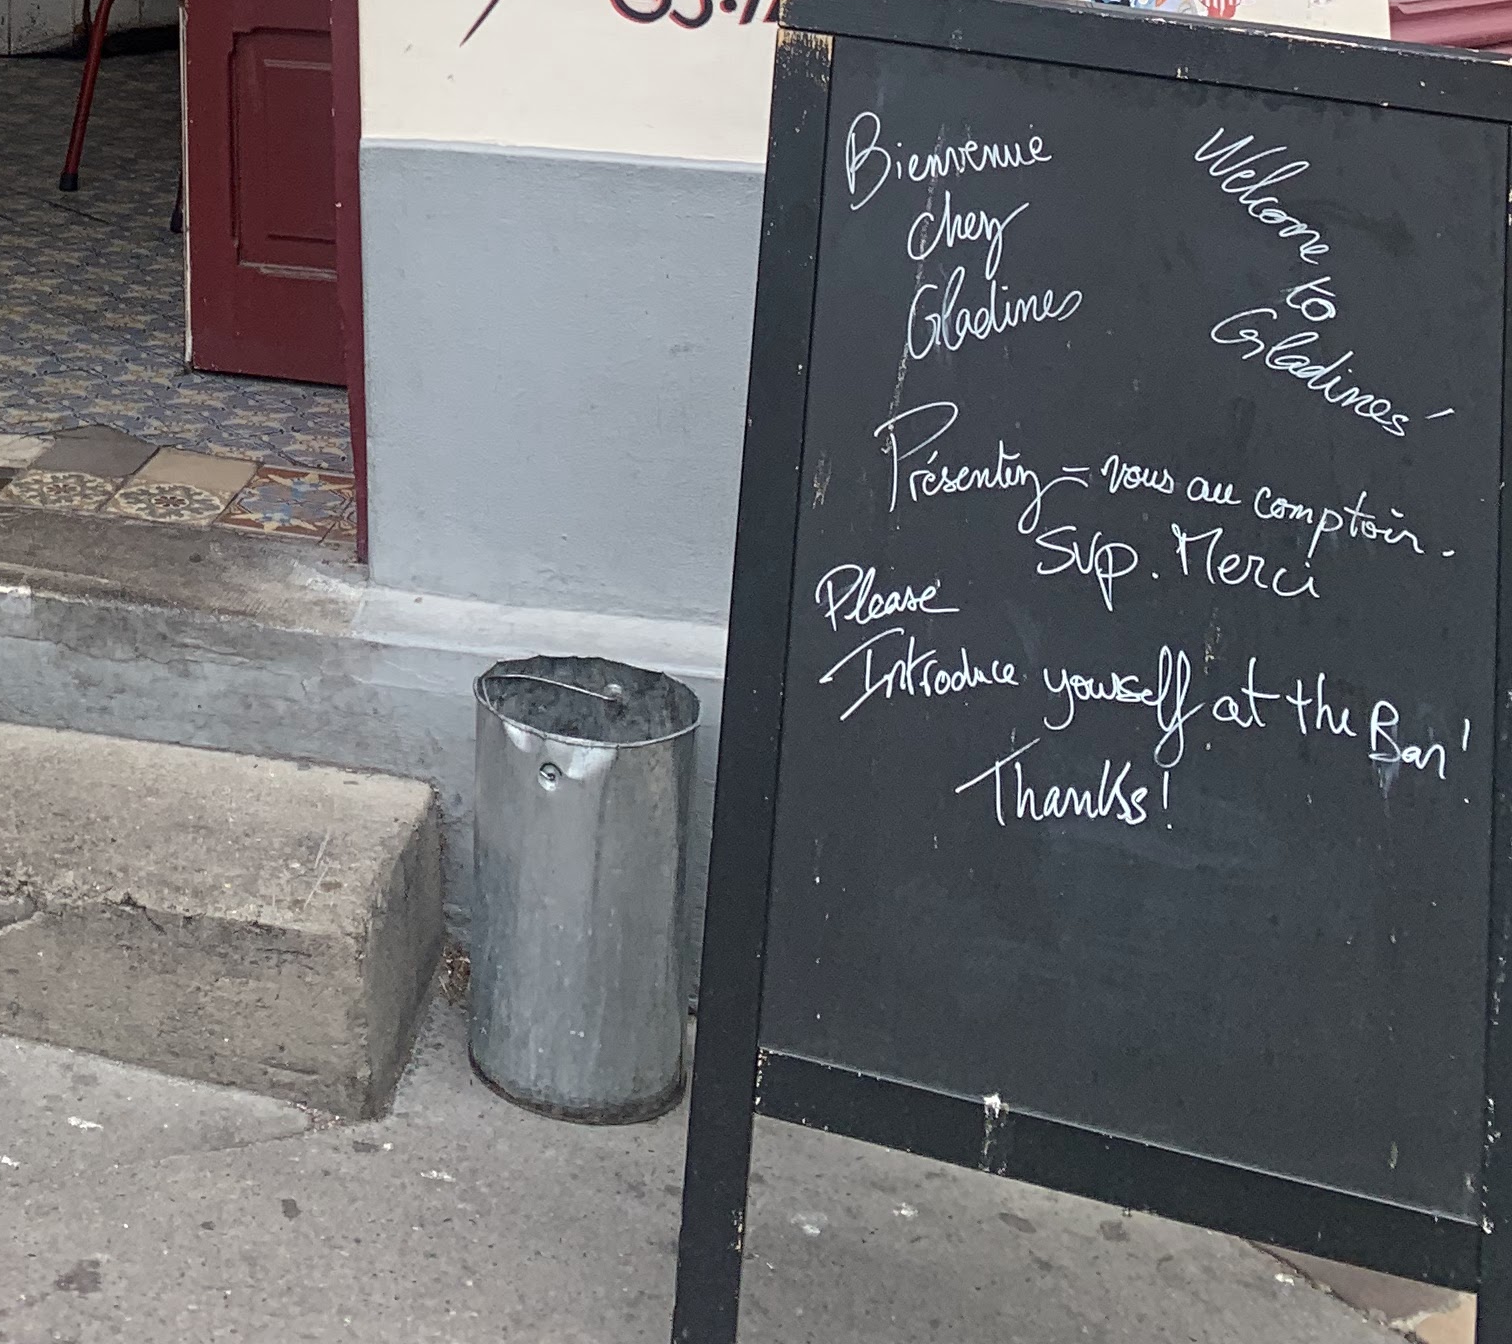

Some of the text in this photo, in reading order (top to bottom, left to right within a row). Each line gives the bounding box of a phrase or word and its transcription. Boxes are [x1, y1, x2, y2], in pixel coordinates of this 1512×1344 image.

[844, 111, 1054, 211] Bienvenue
[1193, 127, 1332, 266] Welcome
[906, 266, 1084, 361] Gladines
[1285, 275, 1338, 324] to
[1186, 476, 1242, 507] au
[815, 563, 960, 632] Please
[1171, 521, 1322, 600] Merci
[819, 627, 1020, 723] Introduce
[1212, 657, 1280, 729] at
[1285, 672, 1357, 738] the
